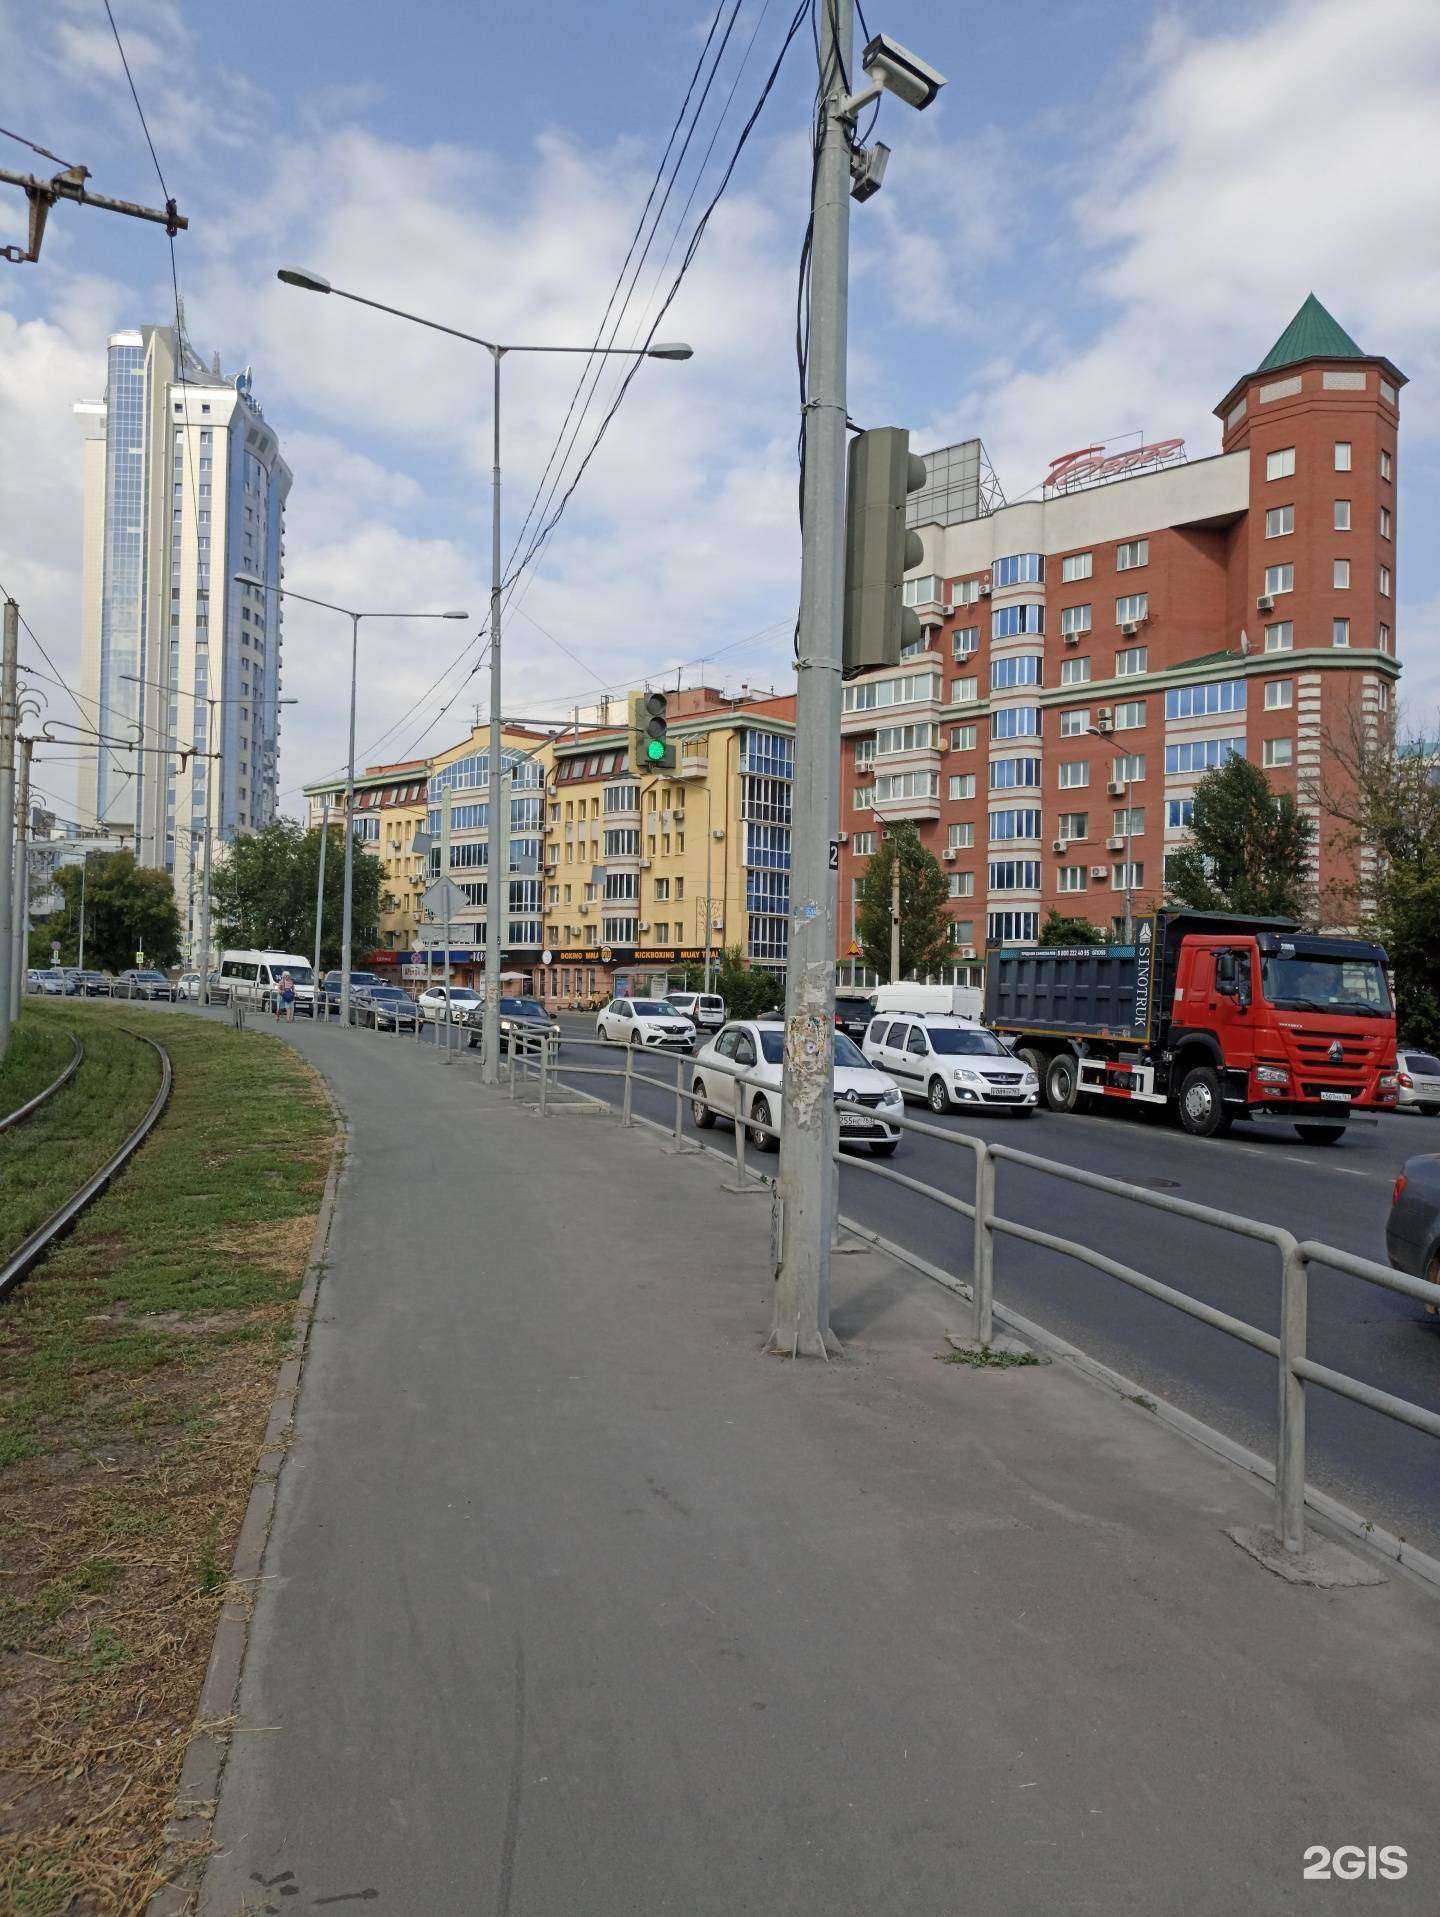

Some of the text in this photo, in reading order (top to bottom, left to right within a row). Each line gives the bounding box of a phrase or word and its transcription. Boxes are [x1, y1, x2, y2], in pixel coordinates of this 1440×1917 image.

[634, 950, 719, 959] KICKBOXING MUAY TAI
[1134, 947, 1151, 1027] SINOTRUK
